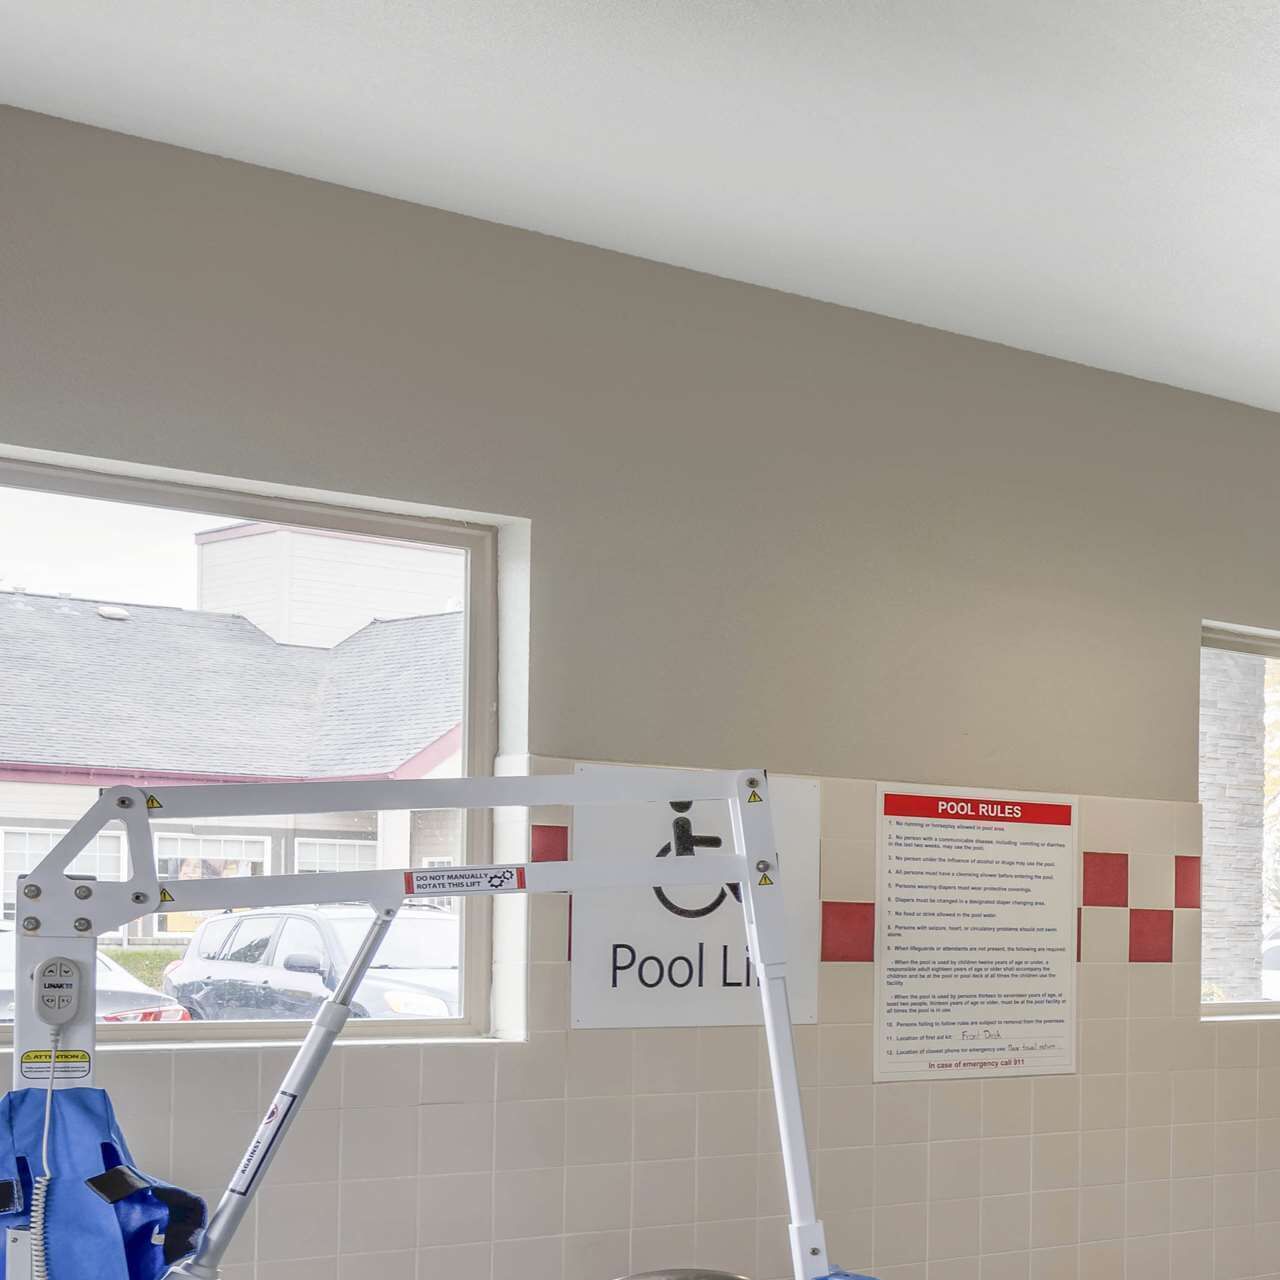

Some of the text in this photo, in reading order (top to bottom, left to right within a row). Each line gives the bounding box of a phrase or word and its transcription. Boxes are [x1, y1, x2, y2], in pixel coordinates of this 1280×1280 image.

[938, 801, 1022, 818] POOL RULES
[416, 882, 446, 890] ROTATE
[466, 880, 480, 888] LIFT
[612, 942, 761, 988] Pool Li
[241, 1140, 262, 1174] AGAINST
